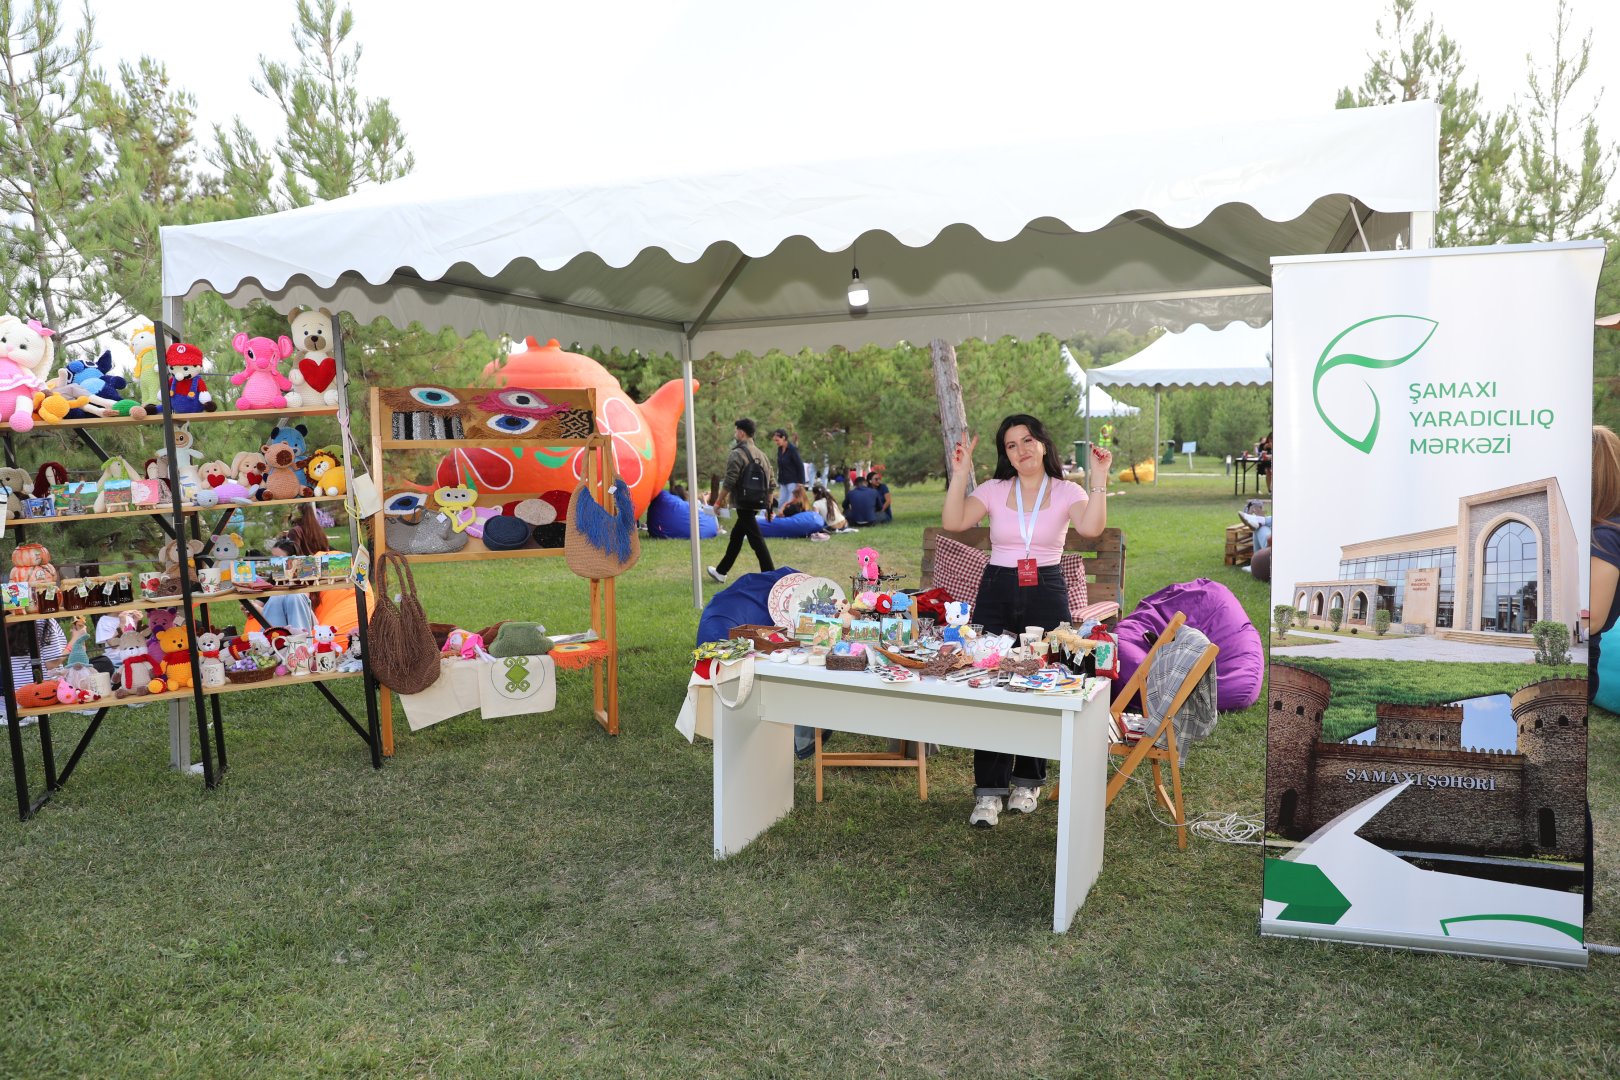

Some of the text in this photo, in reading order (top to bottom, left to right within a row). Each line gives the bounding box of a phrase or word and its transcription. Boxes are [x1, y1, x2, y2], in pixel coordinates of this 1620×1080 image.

[1409, 381, 1497, 405] ŞAMAXI
[1409, 409, 1554, 430] YARADICILIQ
[1410, 434, 1511, 455] MƏRKƏZİ
[1346, 768, 1496, 791] ŞAMAXI ŞƏHƏRİ
